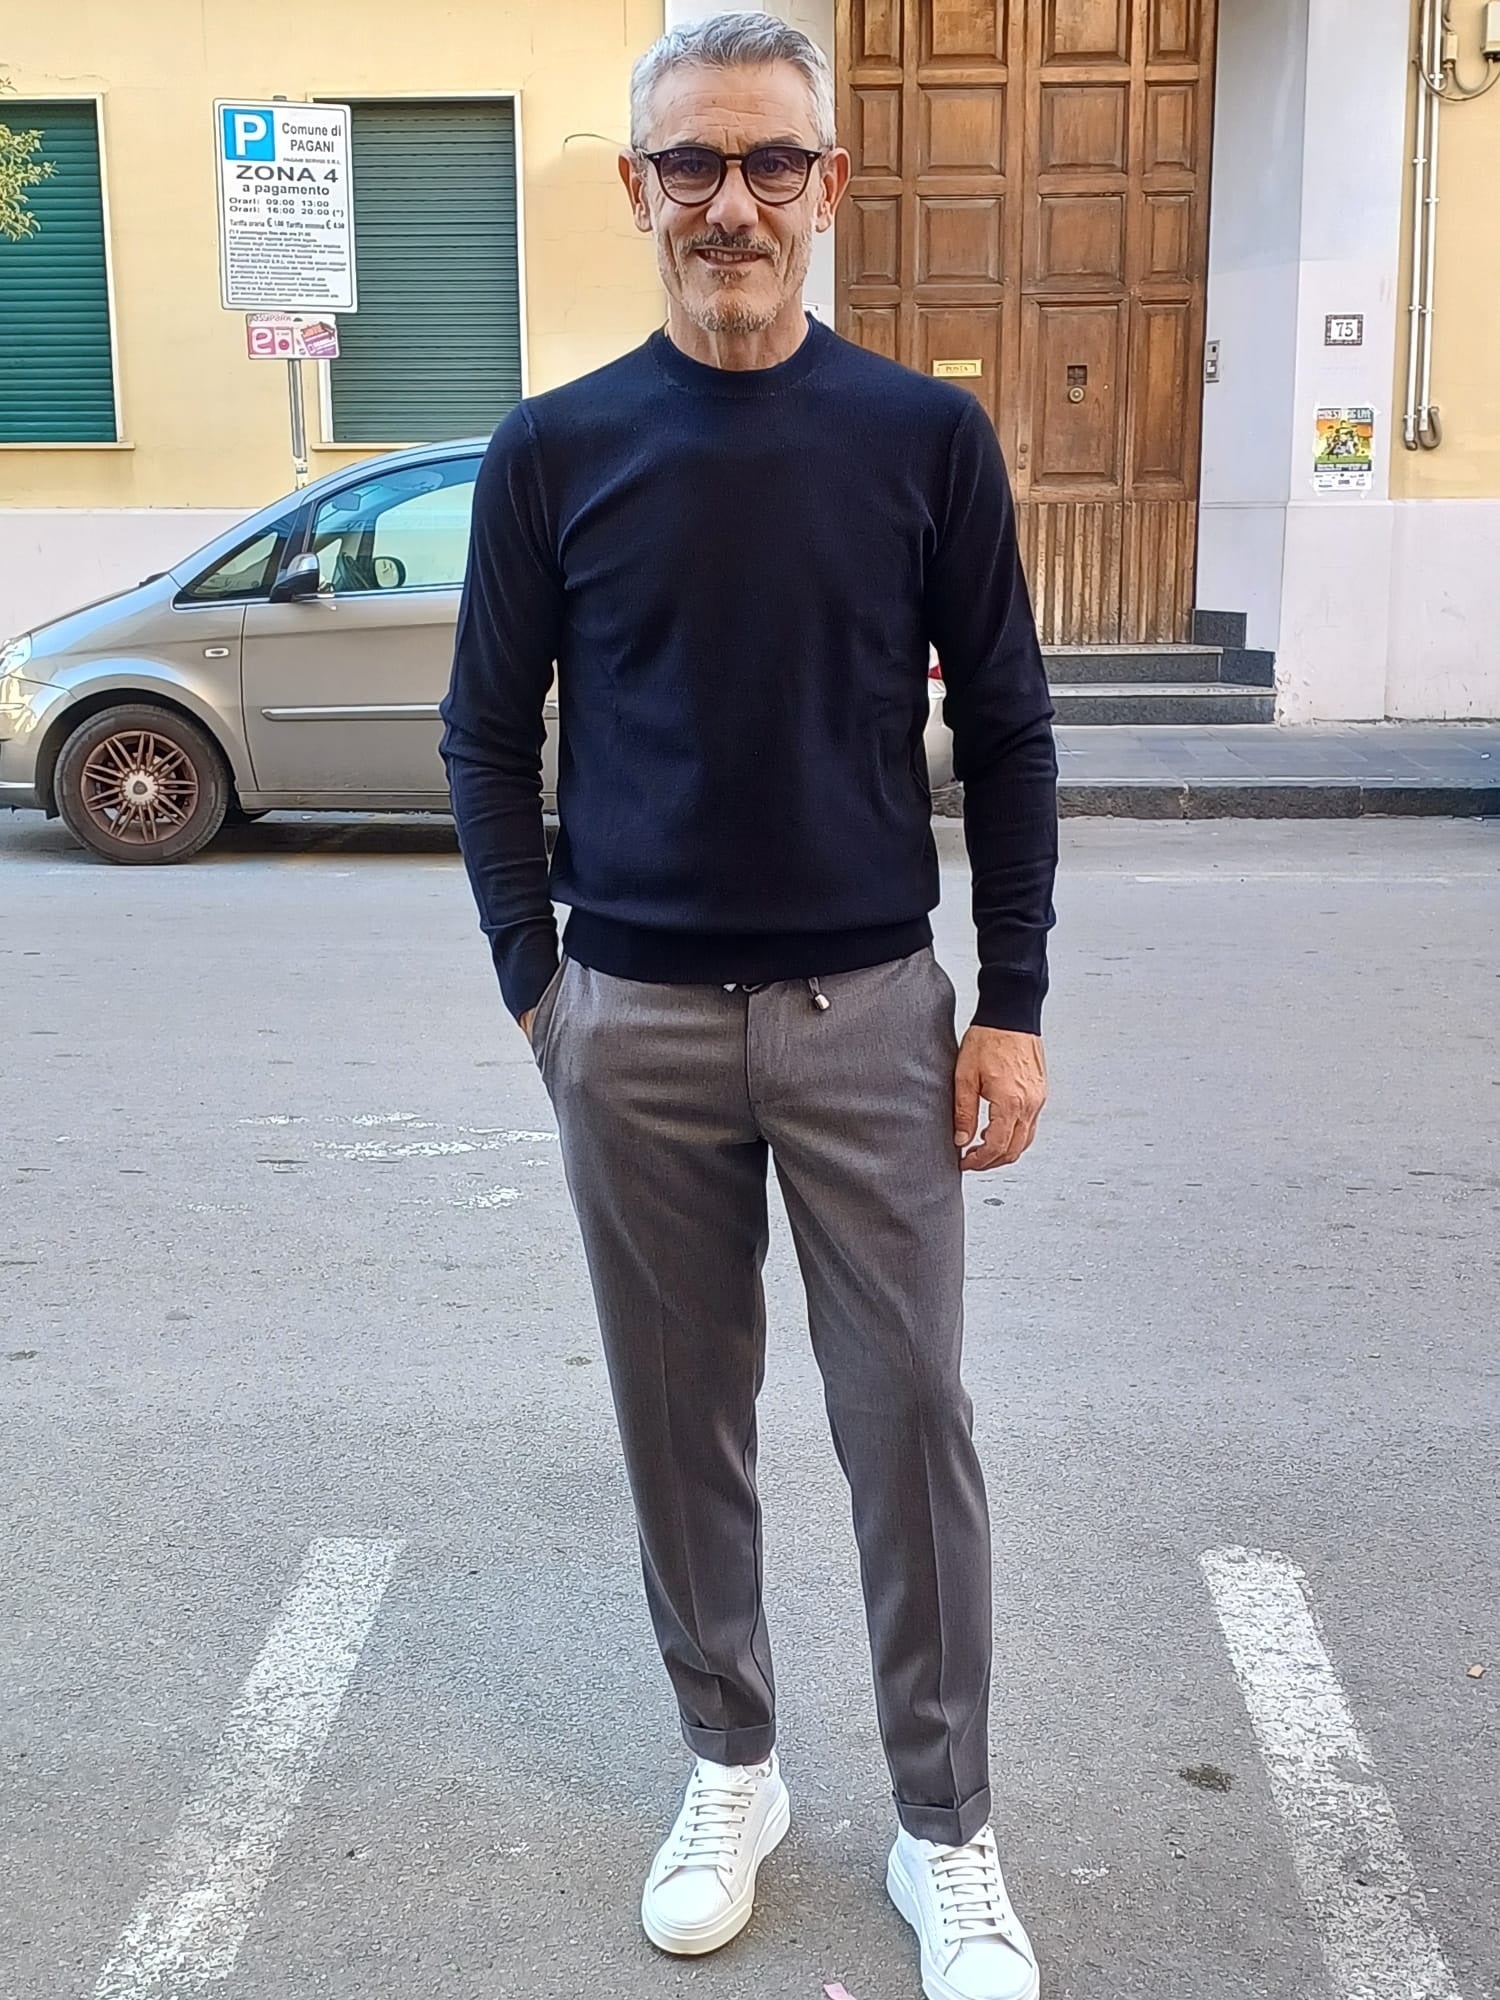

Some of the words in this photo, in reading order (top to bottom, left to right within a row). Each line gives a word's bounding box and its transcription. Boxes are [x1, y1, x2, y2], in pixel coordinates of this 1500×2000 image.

[234, 113, 267, 156] P
[282, 122, 328, 136] Comune
[331, 124, 341, 136] di
[290, 139, 334, 152] PAGANI
[236, 164, 316, 182] ZONA
[323, 168, 339, 183] 4
[242, 184, 250, 192] a
[254, 184, 330, 196] pagamento
[229, 197, 260, 205] Orari:
[266, 198, 295, 206] 09:00
[301, 199, 329, 208] 13:00
[229, 205, 260, 213] Orari:
[267, 206, 295, 215] 16:00
[301, 207, 329, 216] 20:00
[266, 217, 273, 228] €
[326, 219, 331, 230] €
[1336, 322, 1353, 338] 75
